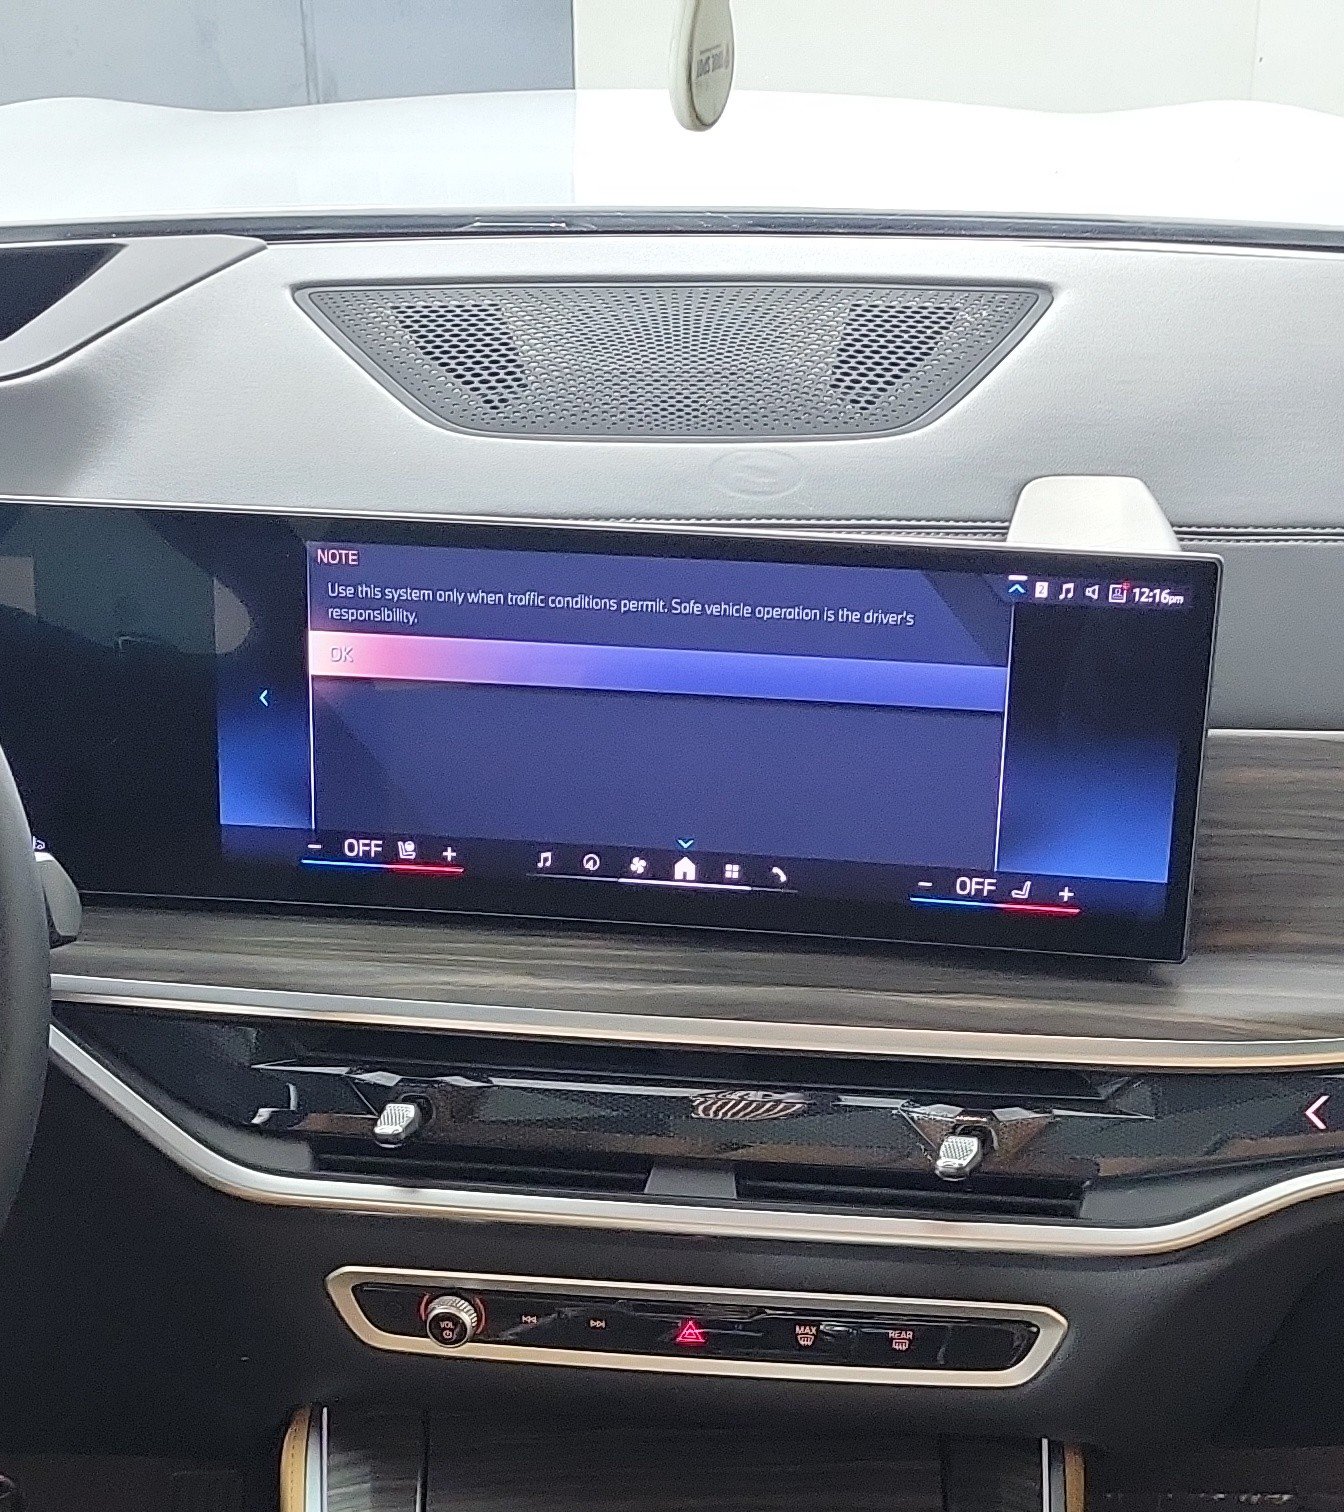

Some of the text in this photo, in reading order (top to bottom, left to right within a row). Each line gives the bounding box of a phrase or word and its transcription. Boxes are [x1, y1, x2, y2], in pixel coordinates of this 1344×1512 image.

[316, 548, 359, 565] NOTE
[327, 581, 915, 626] Use this system only when traffic conditions permit. Safe vehicle operation is the driver's
[1132, 587, 1184, 605] 12:16pm
[327, 606, 419, 626] responsibility.
[330, 645, 355, 663] OK
[343, 837, 384, 858] OFF
[955, 875, 999, 897] OFF
[439, 1321, 455, 1330] VOL
[795, 1324, 817, 1336] MAX
[888, 1330, 913, 1341] REAR
